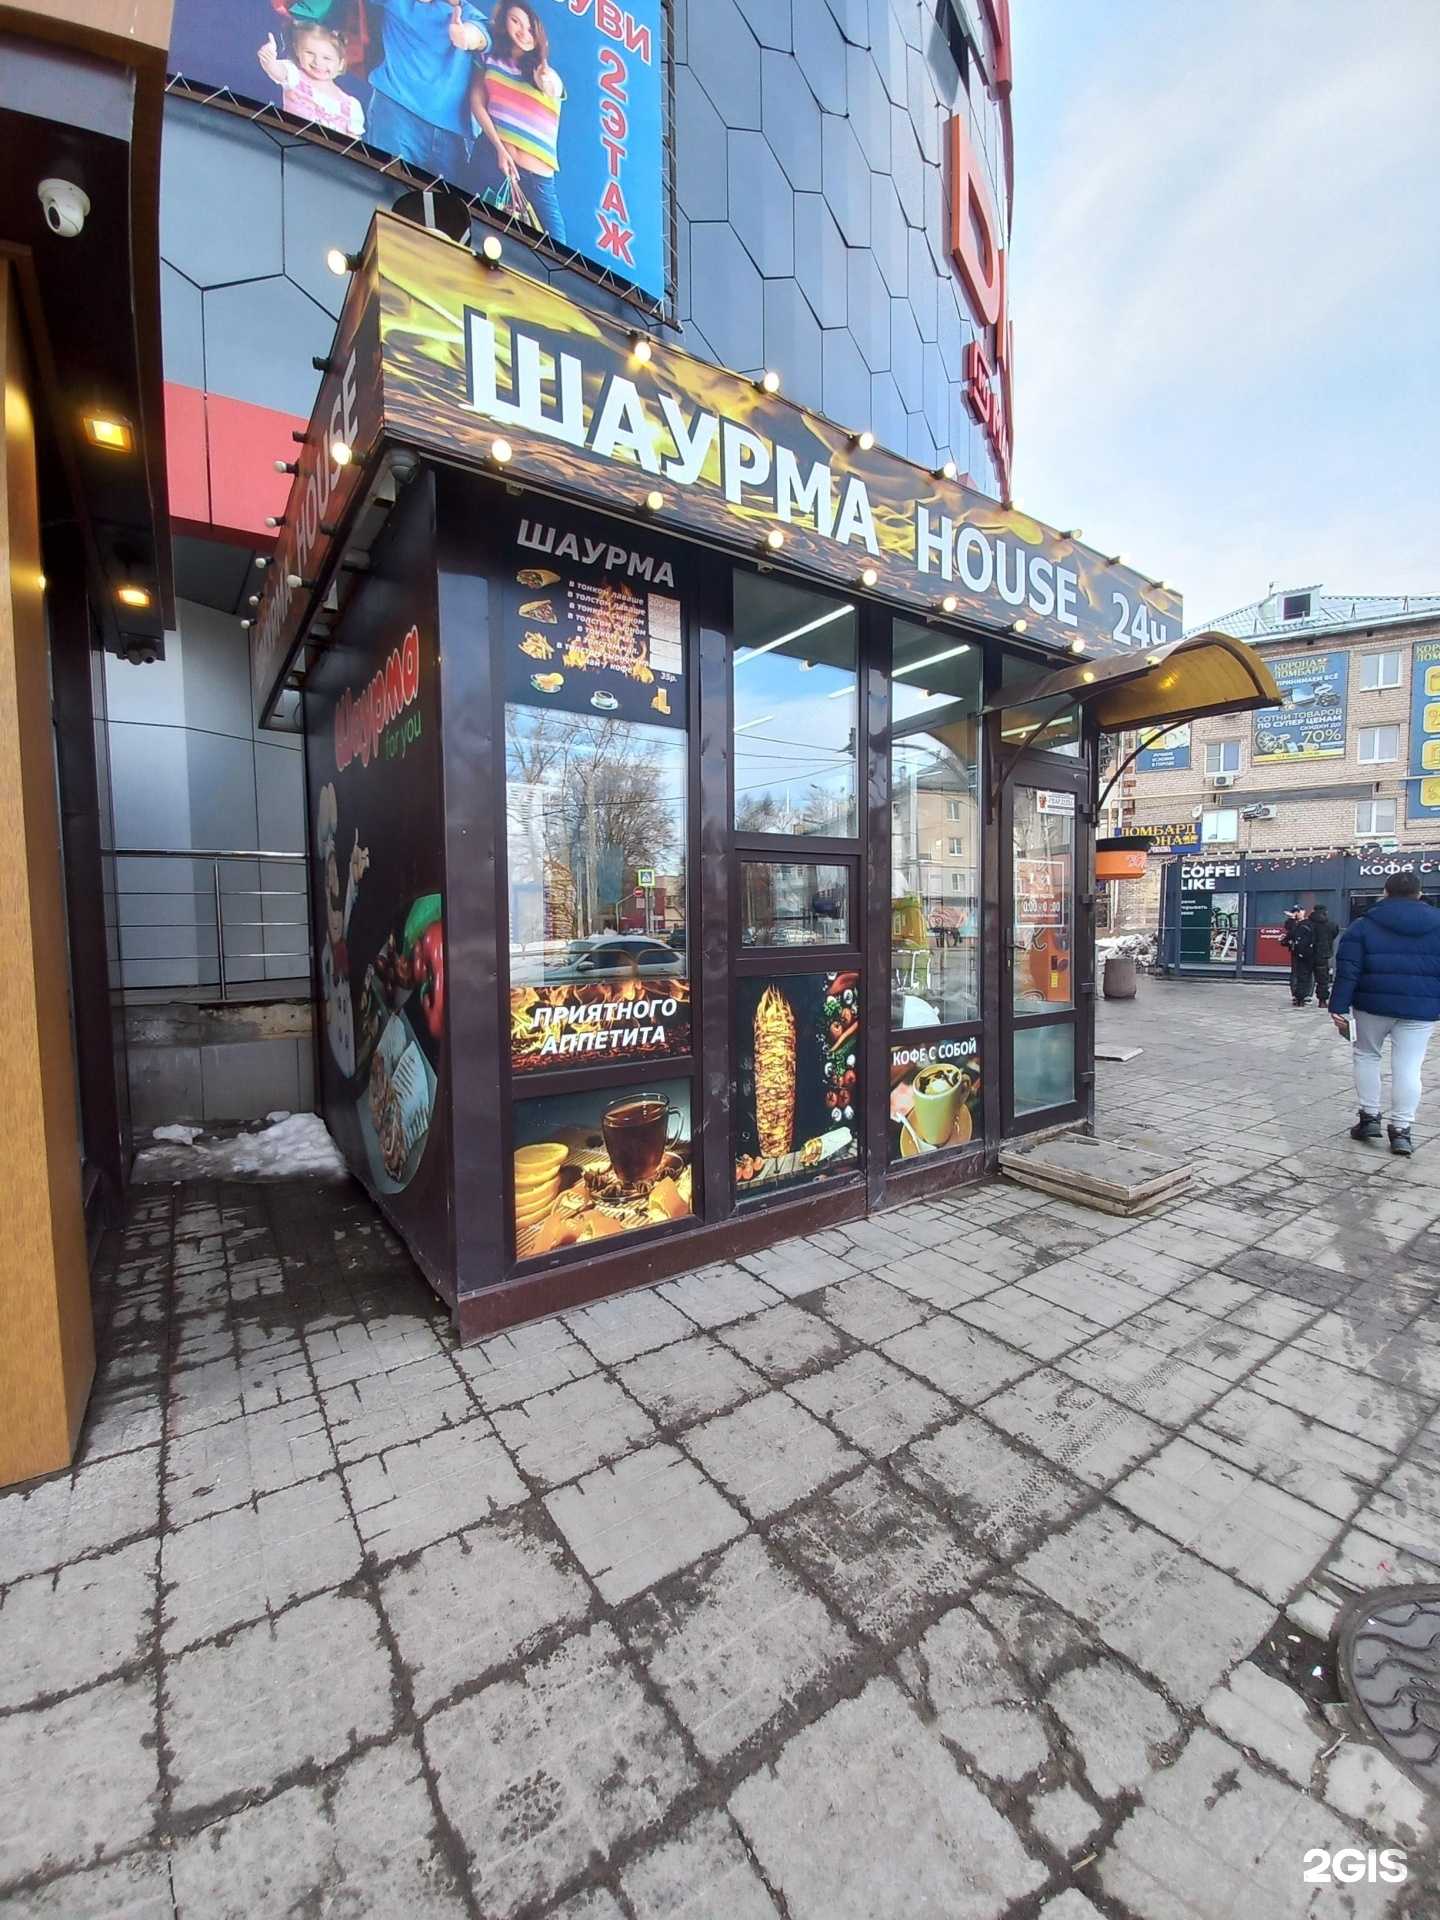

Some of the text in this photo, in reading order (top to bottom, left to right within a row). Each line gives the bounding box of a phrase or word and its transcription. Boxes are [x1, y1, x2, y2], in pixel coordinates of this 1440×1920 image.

[466, 310, 880, 558] ШАУРМА
[916, 502, 1079, 627] HOUSE
[516, 519, 675, 588] ШАУРМА
[577, 582, 609, 594] тонком
[611, 592, 644, 604] лаваше
[575, 592, 611, 606] толстом
[613, 602, 646, 616] лаваше
[577, 603, 609, 616] тонком
[575, 614, 612, 627] толстом
[1274, 660, 1316, 671] КОРОНА
[1274, 666, 1325, 679] ЛОМБАРД
[1276, 676, 1323, 686] ПРИНИМАЕМ
[1257, 708, 1343, 723] СОТНИ ТОВАРОВ
[1273, 719, 1304, 728] СУПЕР
[1306, 715, 1342, 725] ЦЕНАМ
[400, 710, 423, 758] you
[1301, 729, 1341, 743] 70%
[1121, 823, 1196, 837] ЛОМБАРД
[1360, 861, 1432, 875] кофе с
[1181, 878, 1216, 890] LIKE
[530, 998, 678, 1028] ПРИЯТНОГО
[540, 1025, 667, 1056] АППЕТИТА
[892, 1036, 977, 1066] КОФЕ С СОБОЙ
